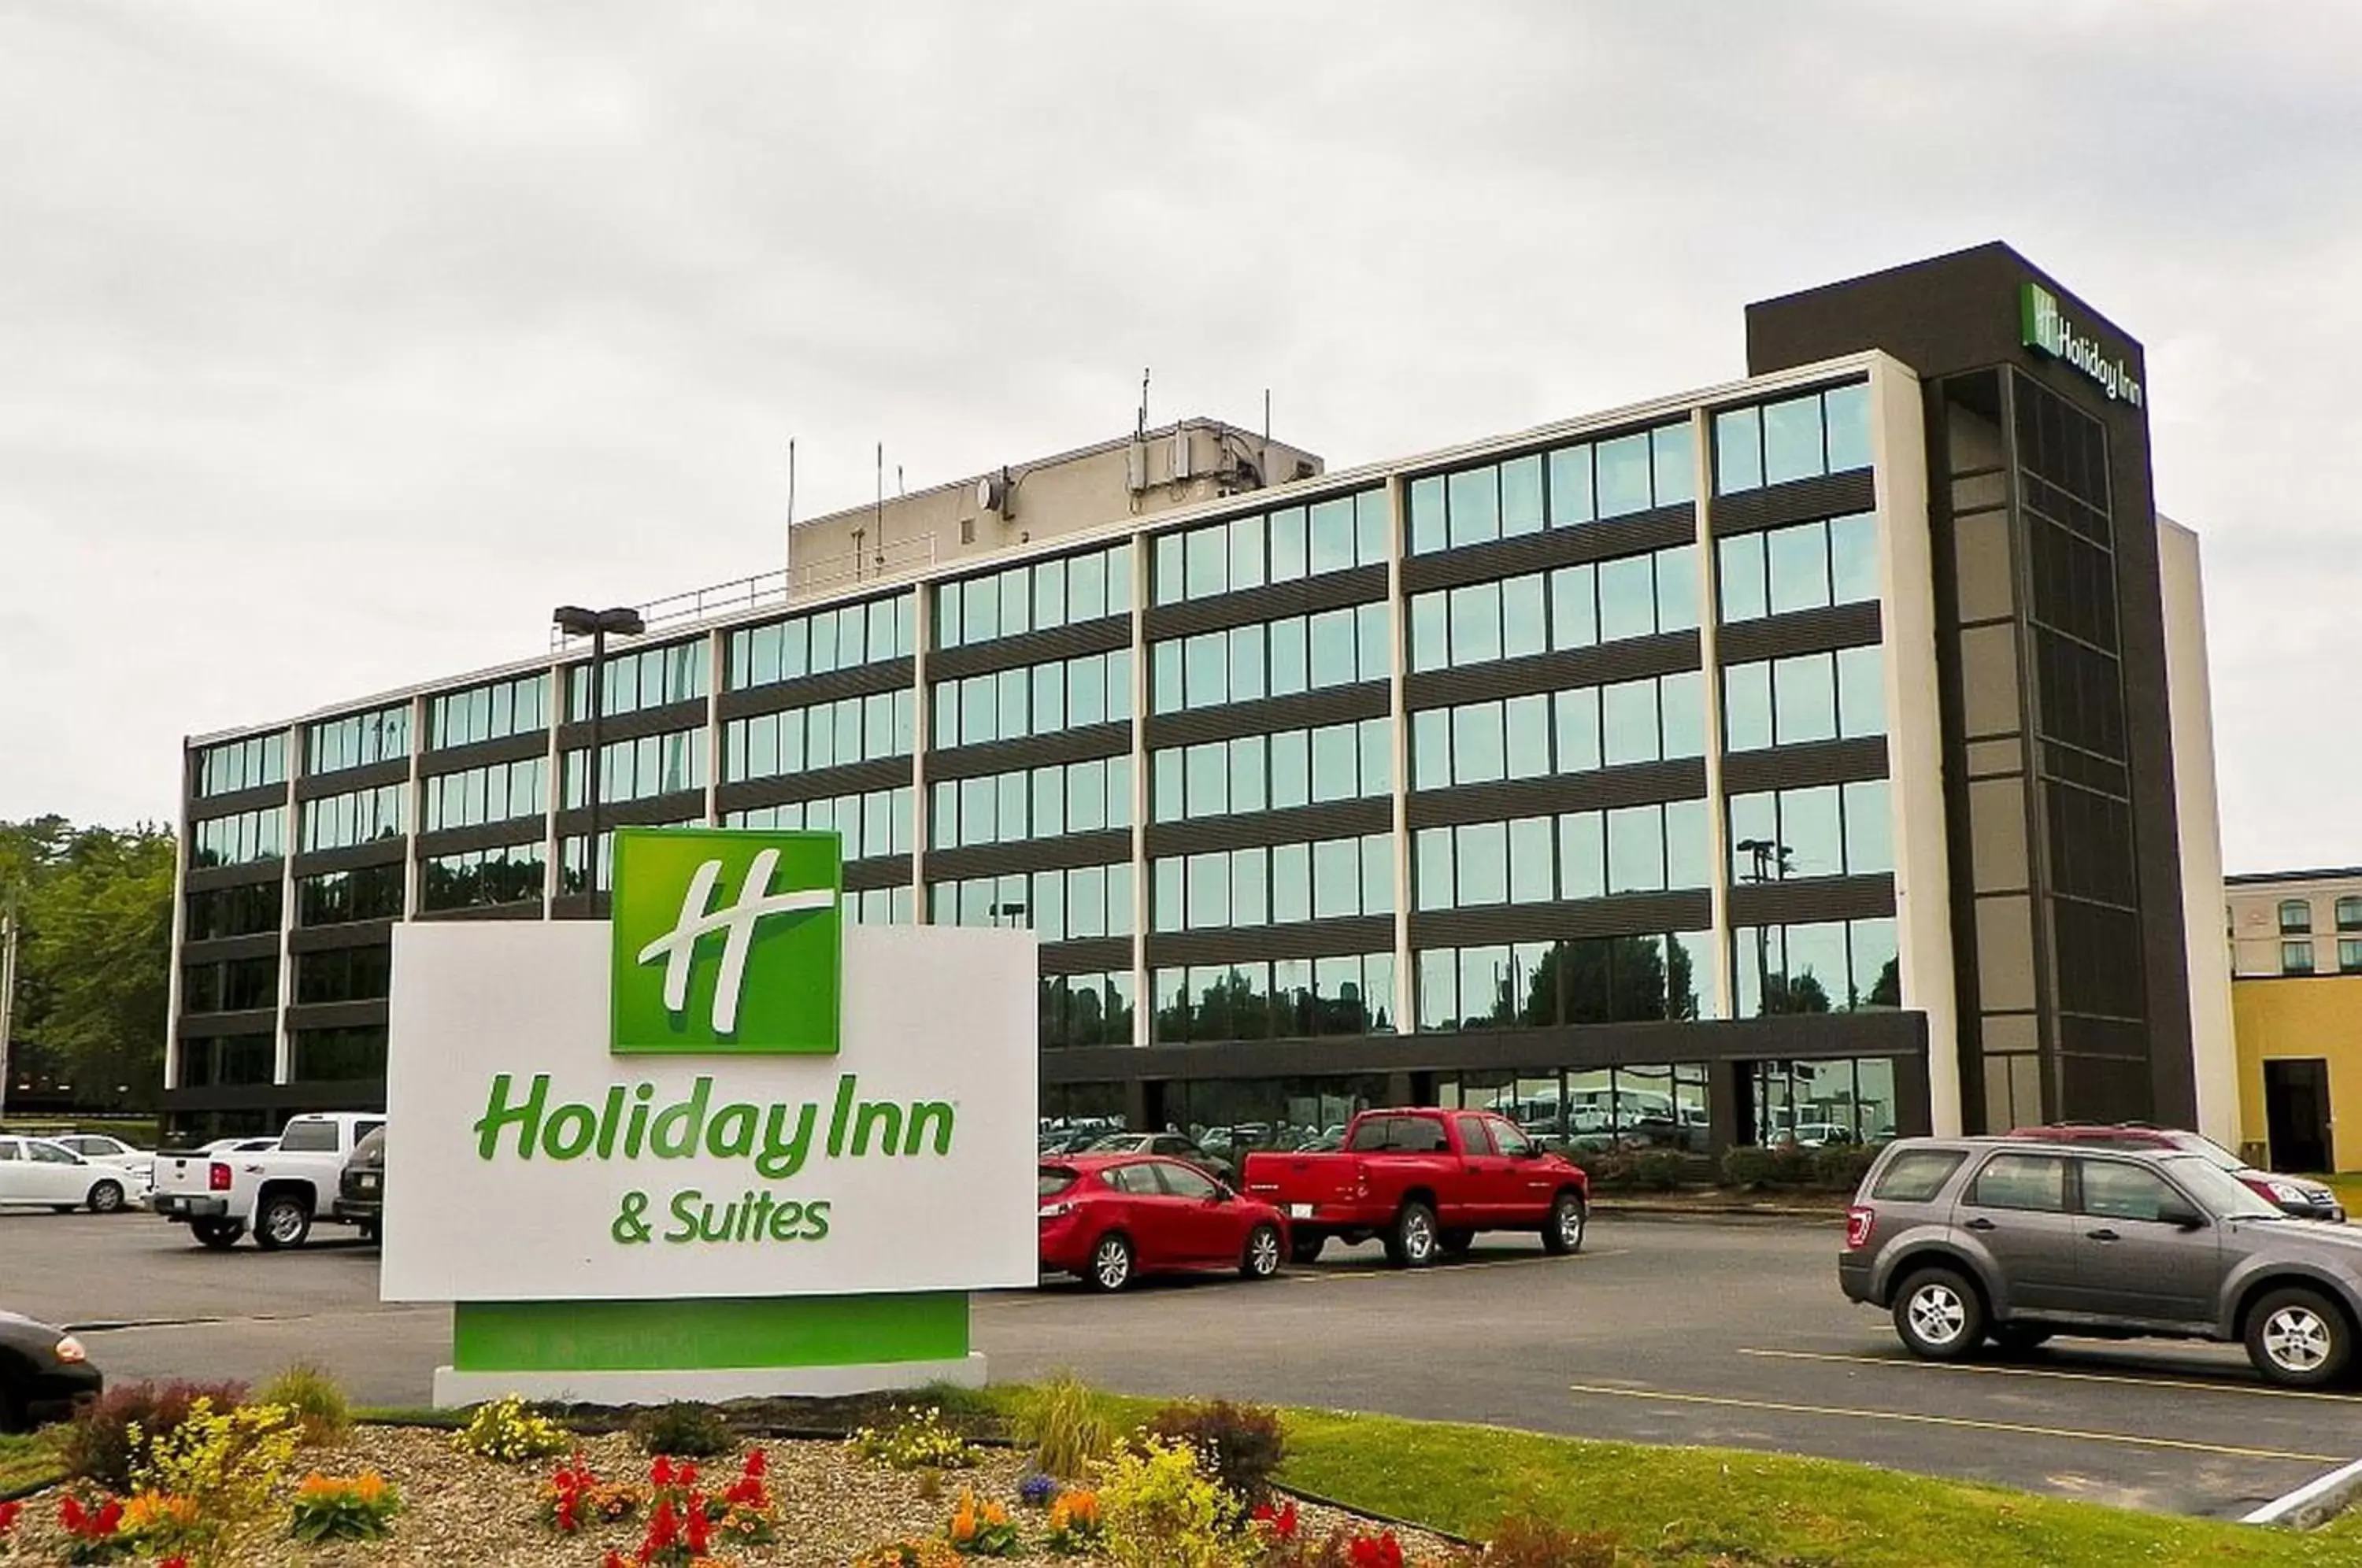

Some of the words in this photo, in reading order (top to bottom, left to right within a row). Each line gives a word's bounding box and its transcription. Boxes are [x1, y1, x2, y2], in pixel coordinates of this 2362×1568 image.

[2057, 316, 2117, 400] Holiday
[2118, 359, 2142, 409] Inn
[474, 1074, 816, 1180] Holiday
[827, 1074, 953, 1158] Inn
[611, 1191, 652, 1244] &
[664, 1190, 831, 1244] Suites
